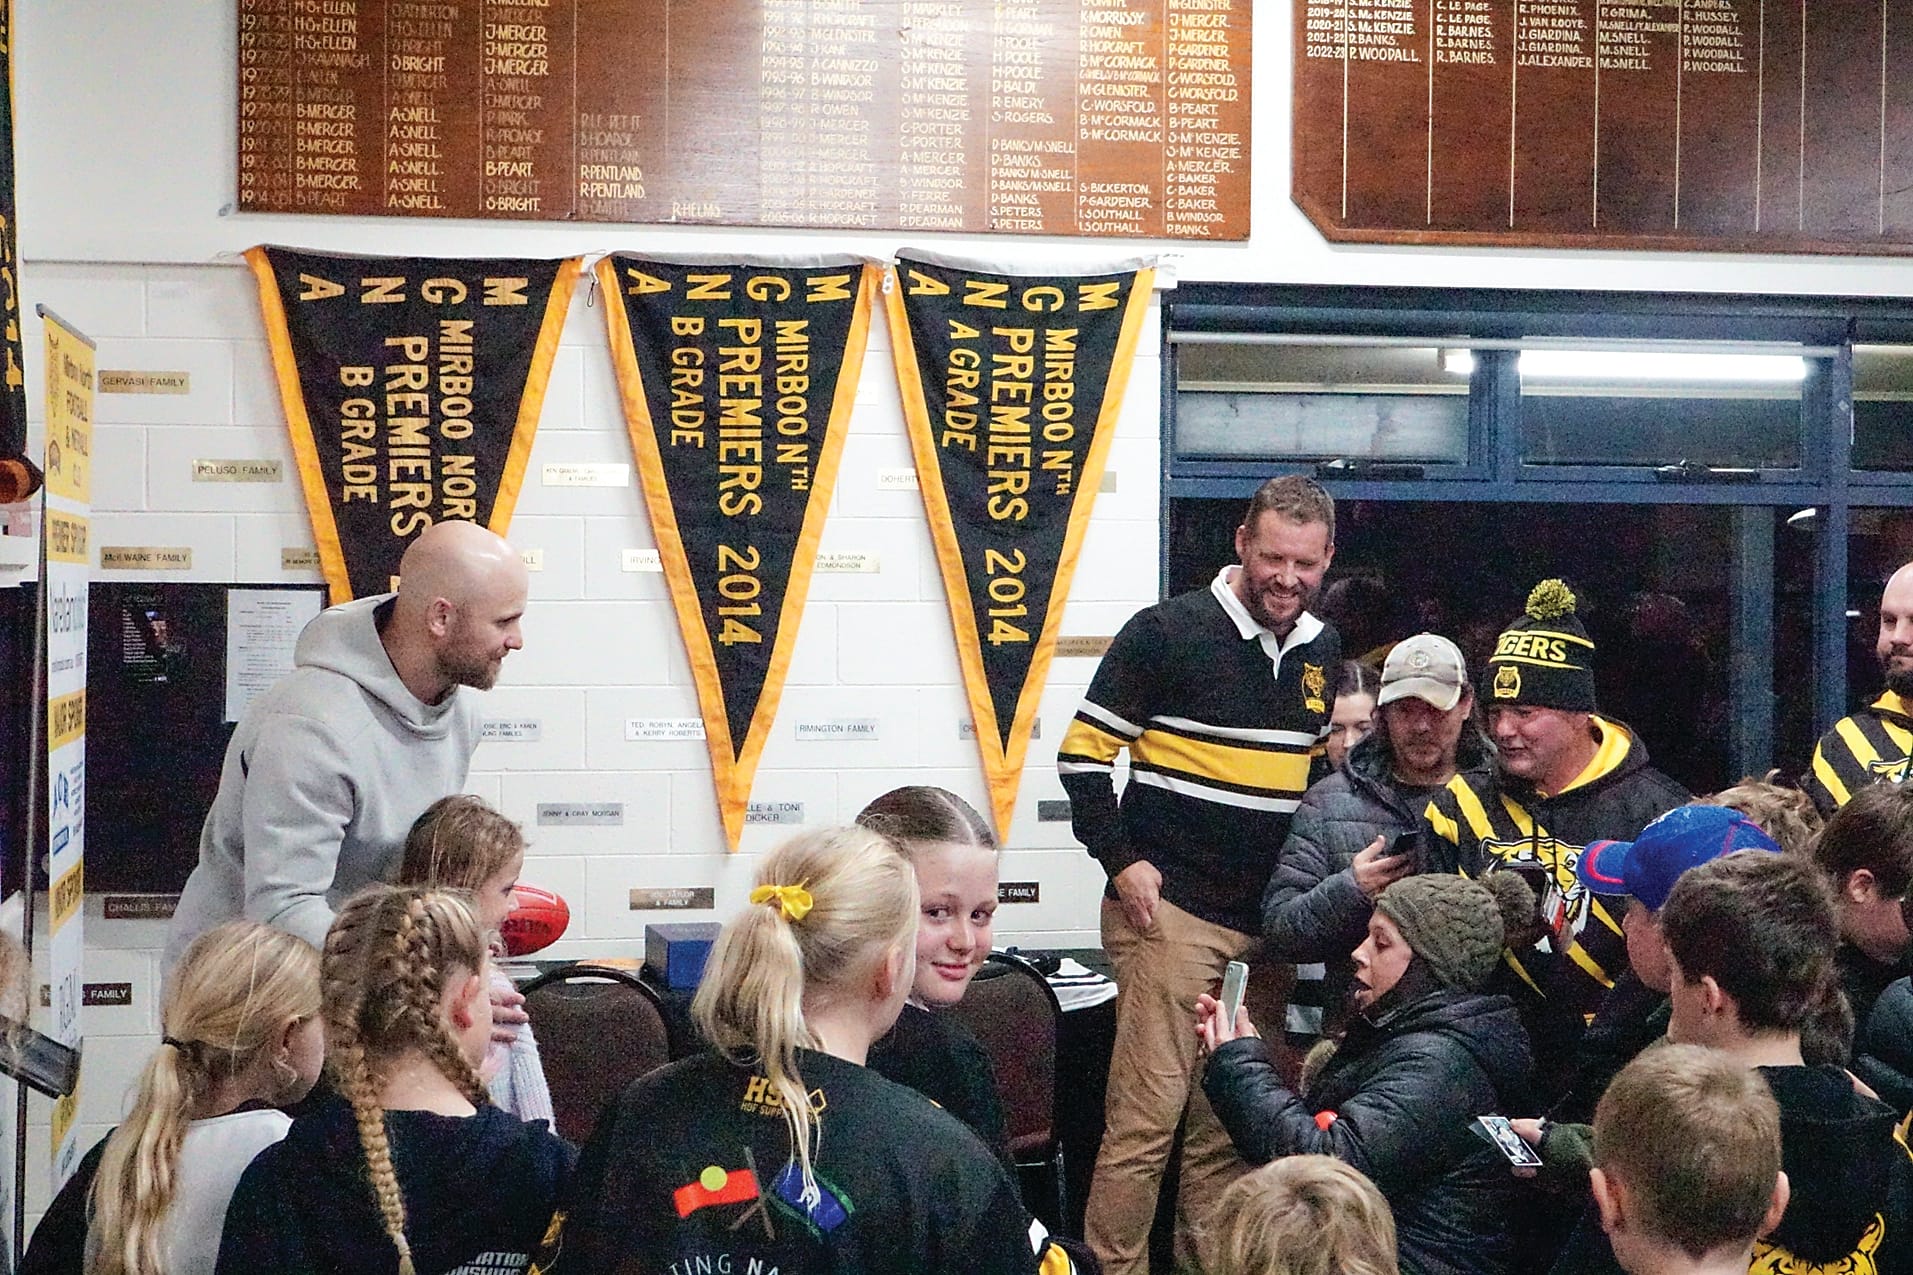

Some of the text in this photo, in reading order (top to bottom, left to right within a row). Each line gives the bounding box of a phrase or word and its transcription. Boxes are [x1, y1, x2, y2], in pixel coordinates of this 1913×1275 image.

[150, 377, 185, 387] FAMILY
[340, 366, 378, 503] B GRADE
[440, 320, 477, 524] MIRBOO NOR
[671, 317, 705, 448] B GRADE
[776, 320, 809, 435] MIRBOO
[941, 319, 981, 452] A GRADE
[1042, 328, 1078, 442] MIRBOO
[243, 466, 277, 476] FAMILY
[385, 336, 434, 537] PREMIERS
[717, 318, 763, 647] PREMIERS 2014
[985, 327, 1035, 647] PREMIERS 2014
[156, 553, 187, 562] FAMILY
[1494, 635, 1566, 662] IGERS
[847, 724, 876, 733] FAMILY
[1008, 888, 1036, 897] FAMILY
[91, 988, 127, 999] FAMILY
